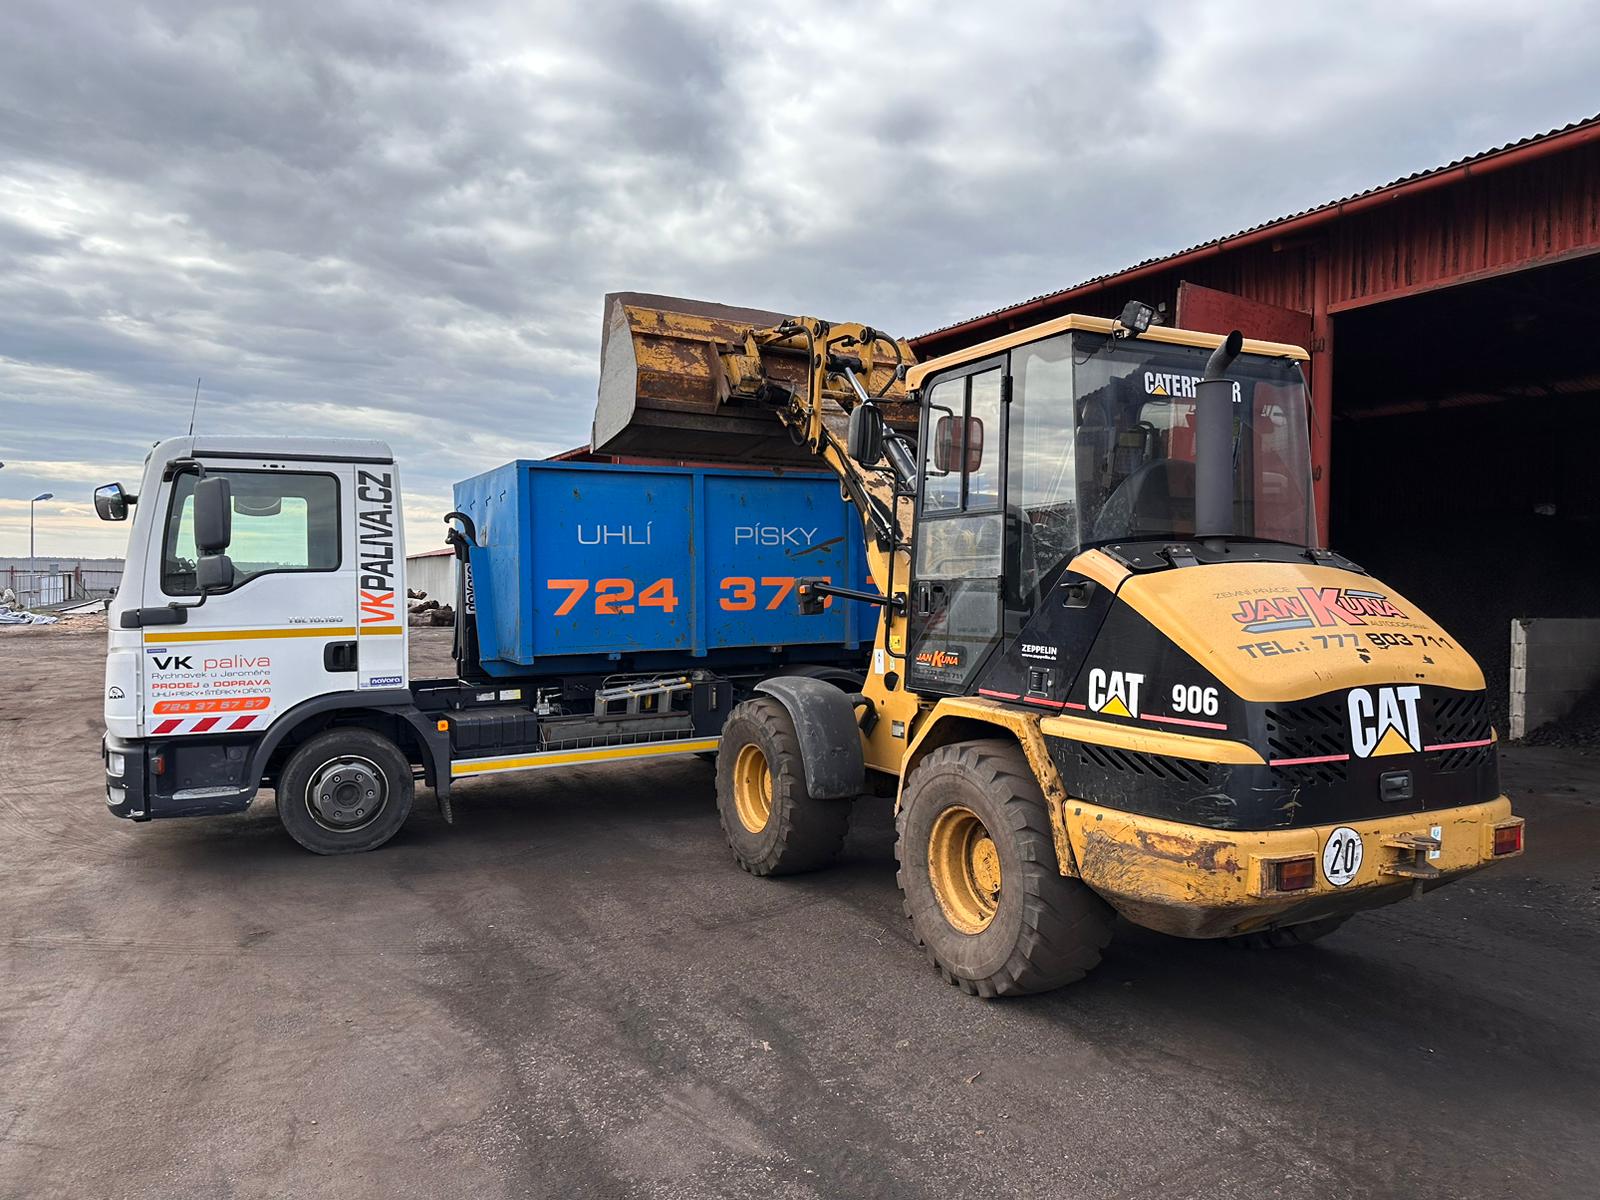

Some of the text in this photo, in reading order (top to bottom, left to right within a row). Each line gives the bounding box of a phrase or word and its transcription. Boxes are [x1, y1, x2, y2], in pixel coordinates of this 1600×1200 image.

[1144, 371, 1241, 403] CATERPR
[357, 470, 395, 624] VKPALIVA.CZ
[577, 521, 653, 545] UHLÍ
[734, 522, 818, 546] PÍSKY
[547, 578, 679, 616] 724
[1021, 643, 1058, 656] ZEPPELIN
[1311, 633, 1360, 649] 777
[1365, 633, 1414, 647] 803
[1412, 634, 1455, 649] 711
[152, 654, 271, 672] VK paliva
[152, 672, 208, 681] Rychnovek
[213, 679, 271, 688] DOPRAVA
[1088, 667, 1145, 719] CAT
[1171, 684, 1219, 716] 906
[1347, 685, 1422, 759] CAT
[1330, 838, 1356, 876] 20
